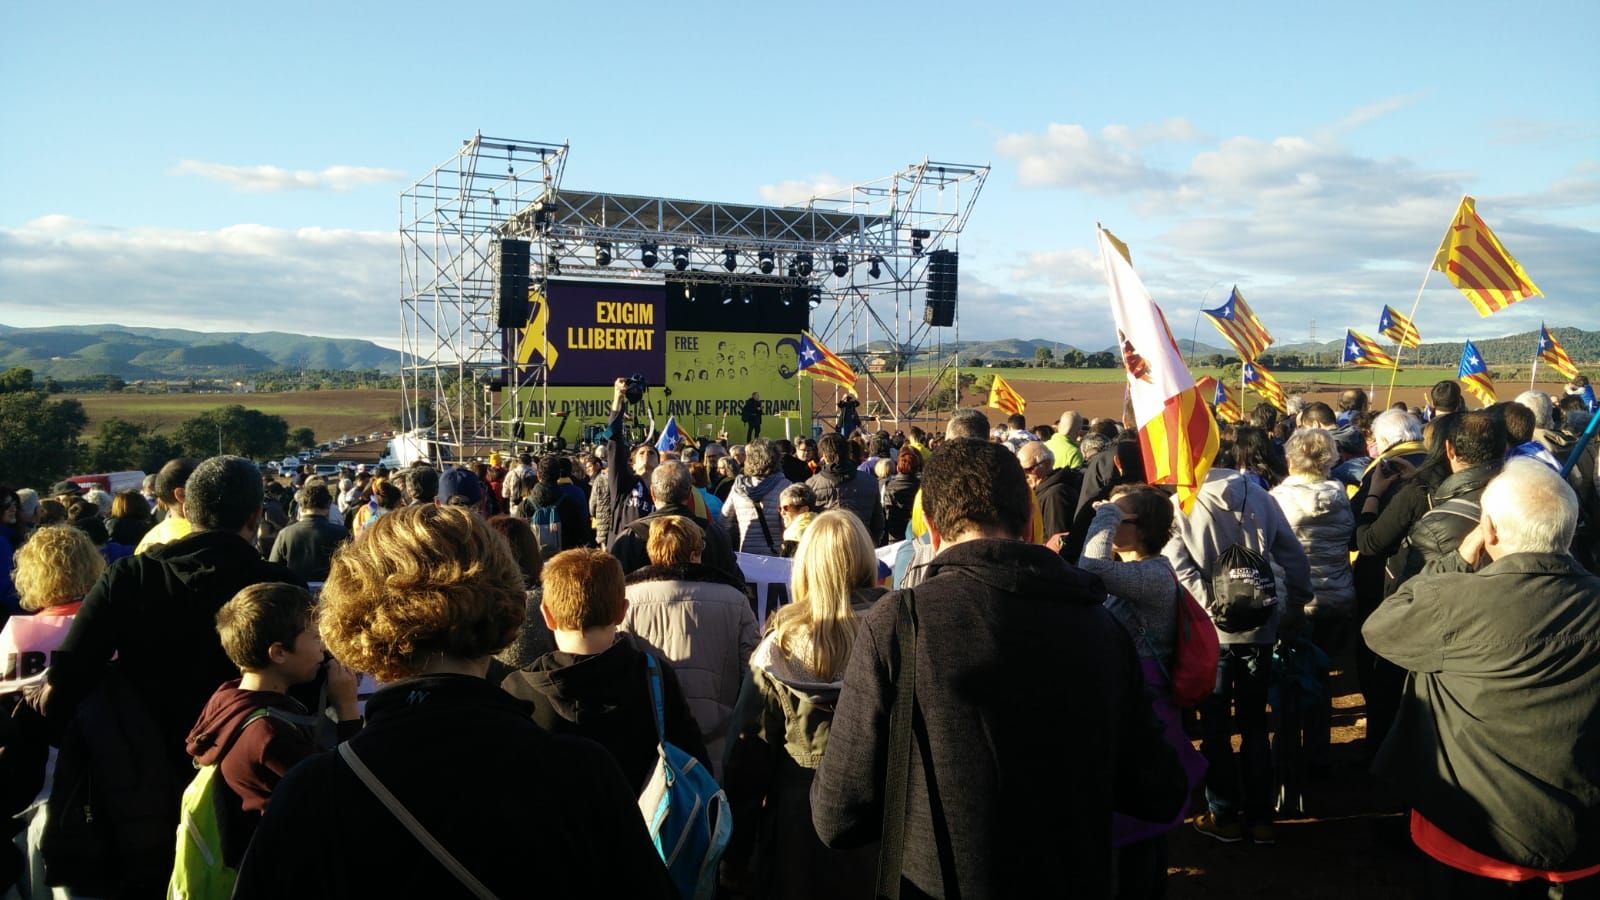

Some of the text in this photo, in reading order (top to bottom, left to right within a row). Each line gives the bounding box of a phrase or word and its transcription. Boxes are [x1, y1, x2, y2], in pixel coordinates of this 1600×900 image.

[596, 301, 653, 325] EXIGIM
[567, 327, 655, 350] LLIBERTAT
[675, 336, 699, 350] FREE
[667, 399, 692, 416] ANY
[696, 399, 711, 416] DE
